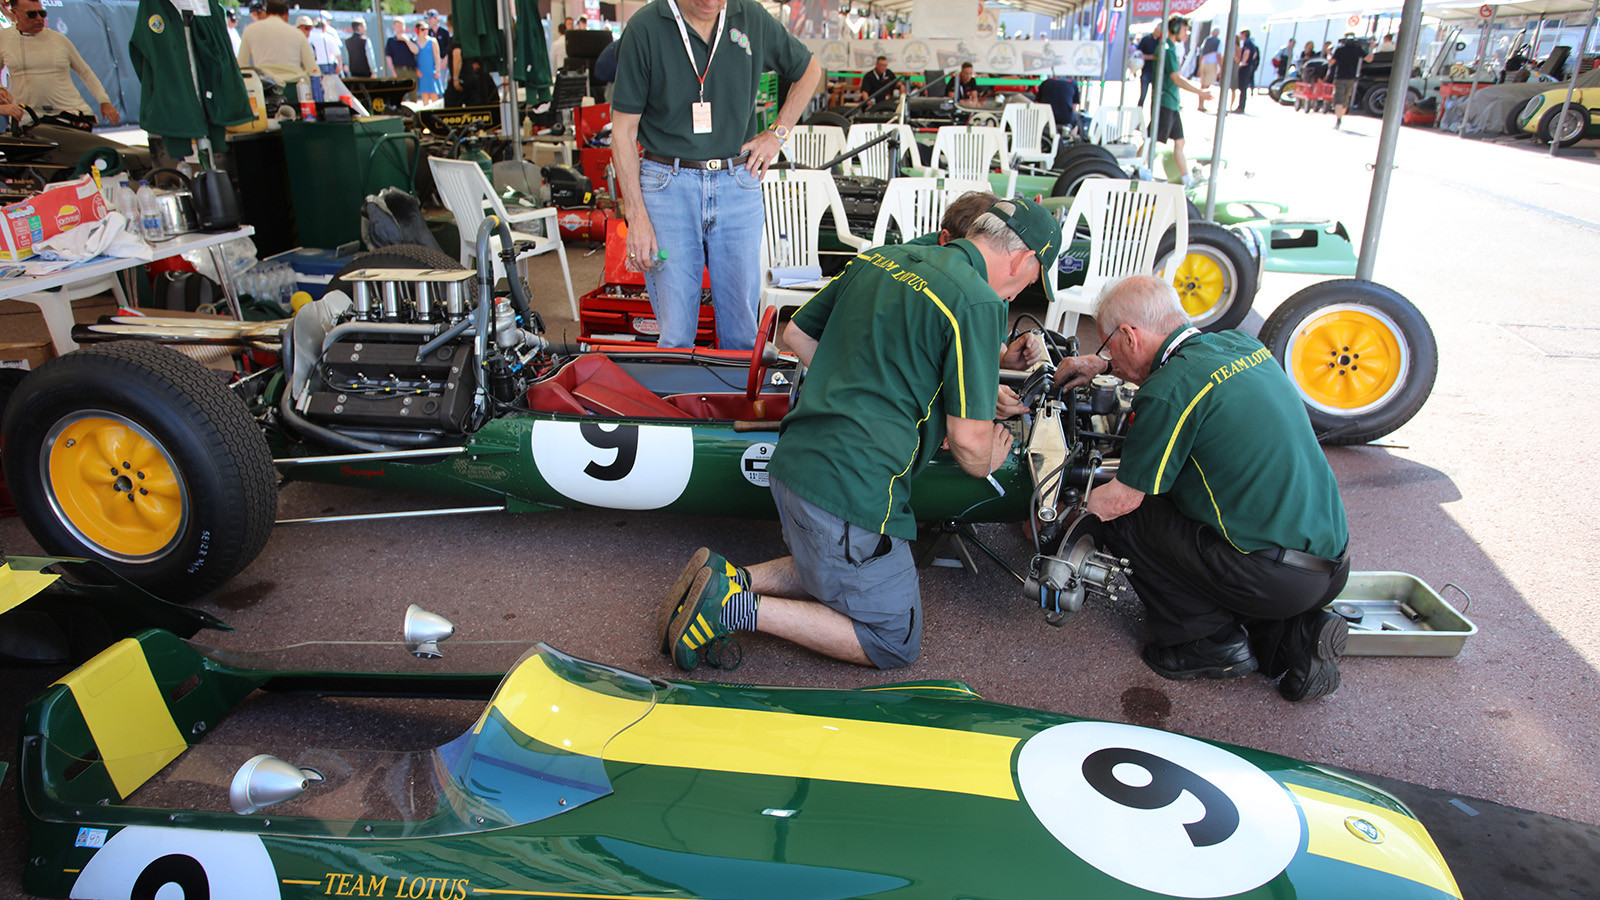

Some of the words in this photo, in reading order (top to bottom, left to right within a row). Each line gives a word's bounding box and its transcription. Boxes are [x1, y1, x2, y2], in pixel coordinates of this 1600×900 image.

[868, 253, 900, 272] TEAM
[891, 270, 928, 291] LOTUS
[1210, 357, 1250, 385] TEAM
[759, 446, 768, 455] 9
[1082, 747, 1240, 847] 9
[324, 873, 389, 897] TEAM
[395, 876, 470, 900] LOTUS
